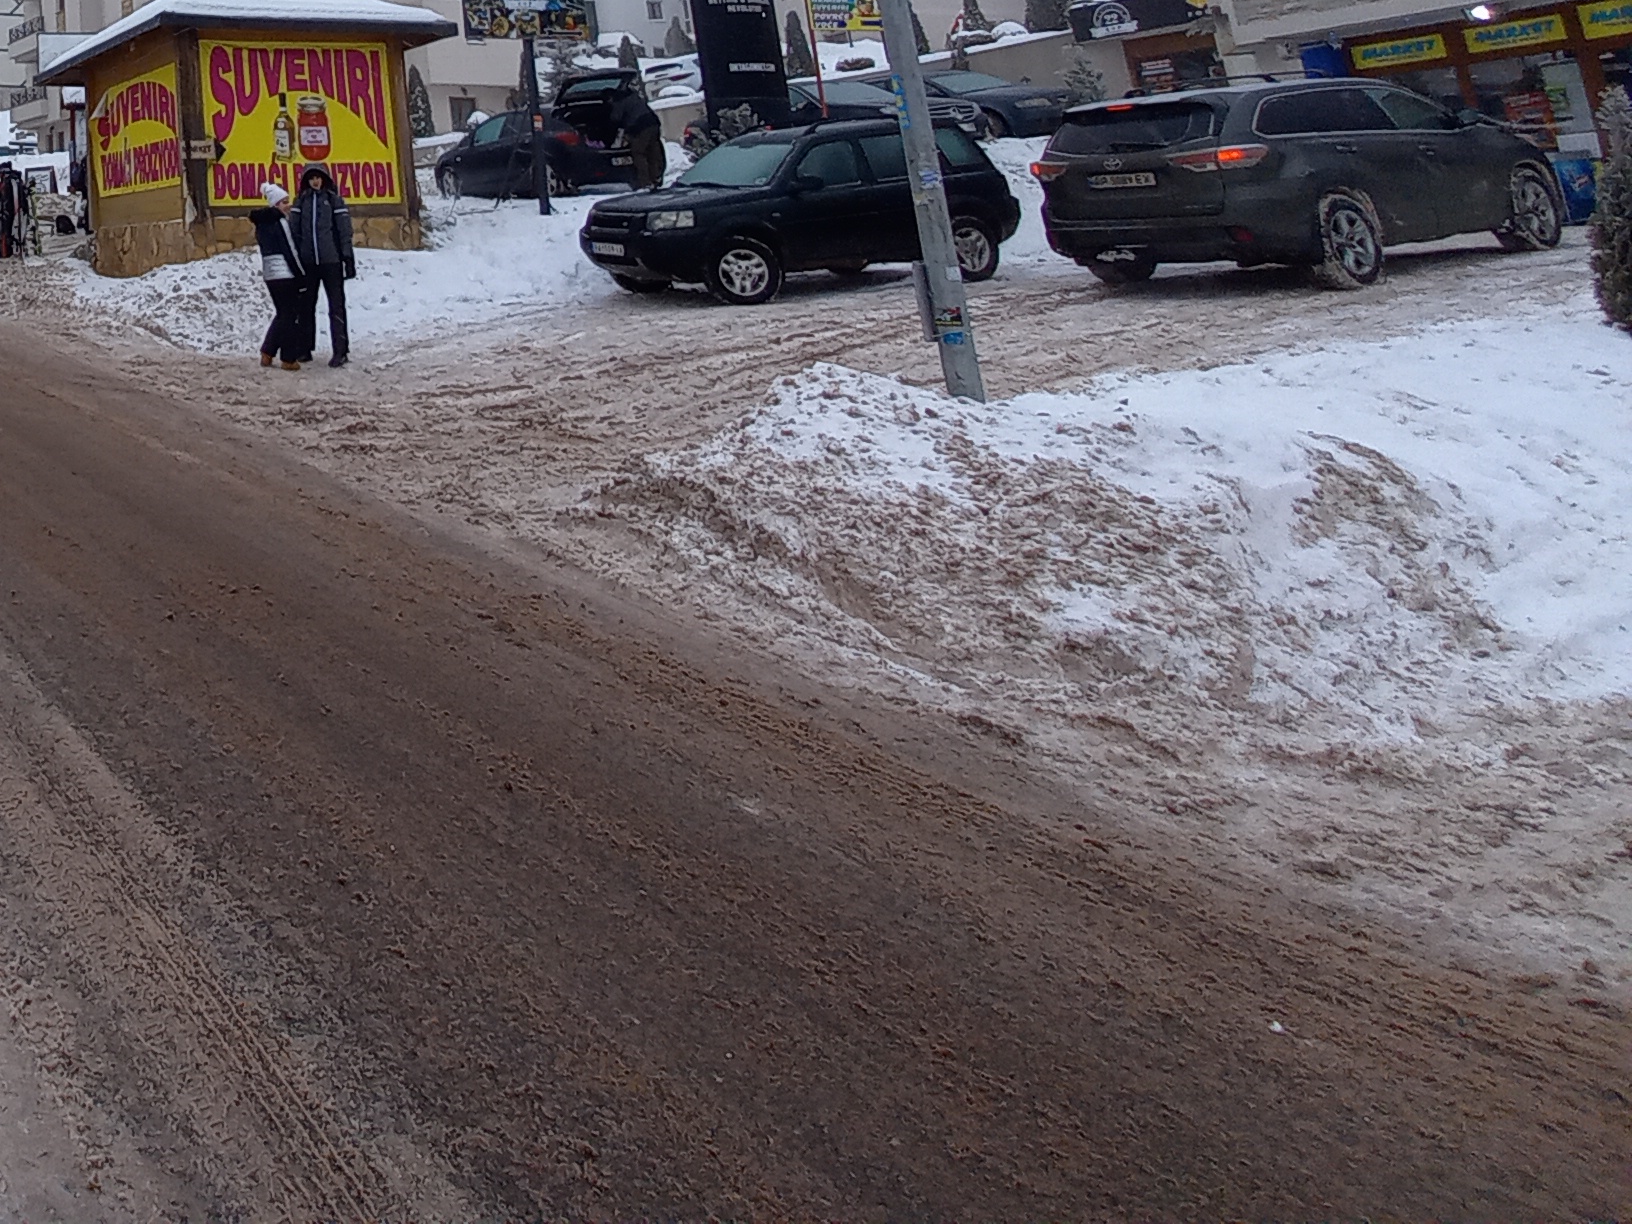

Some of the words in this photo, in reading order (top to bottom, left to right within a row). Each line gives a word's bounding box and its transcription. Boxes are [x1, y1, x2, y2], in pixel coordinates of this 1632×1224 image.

[1475, 19, 1555, 43] MARKET
[1362, 39, 1435, 60] MARKET
[210, 45, 389, 149] SUVENIRI
[98, 81, 177, 151] SUVENIRI
[293, 162, 395, 198] PIZVODI
